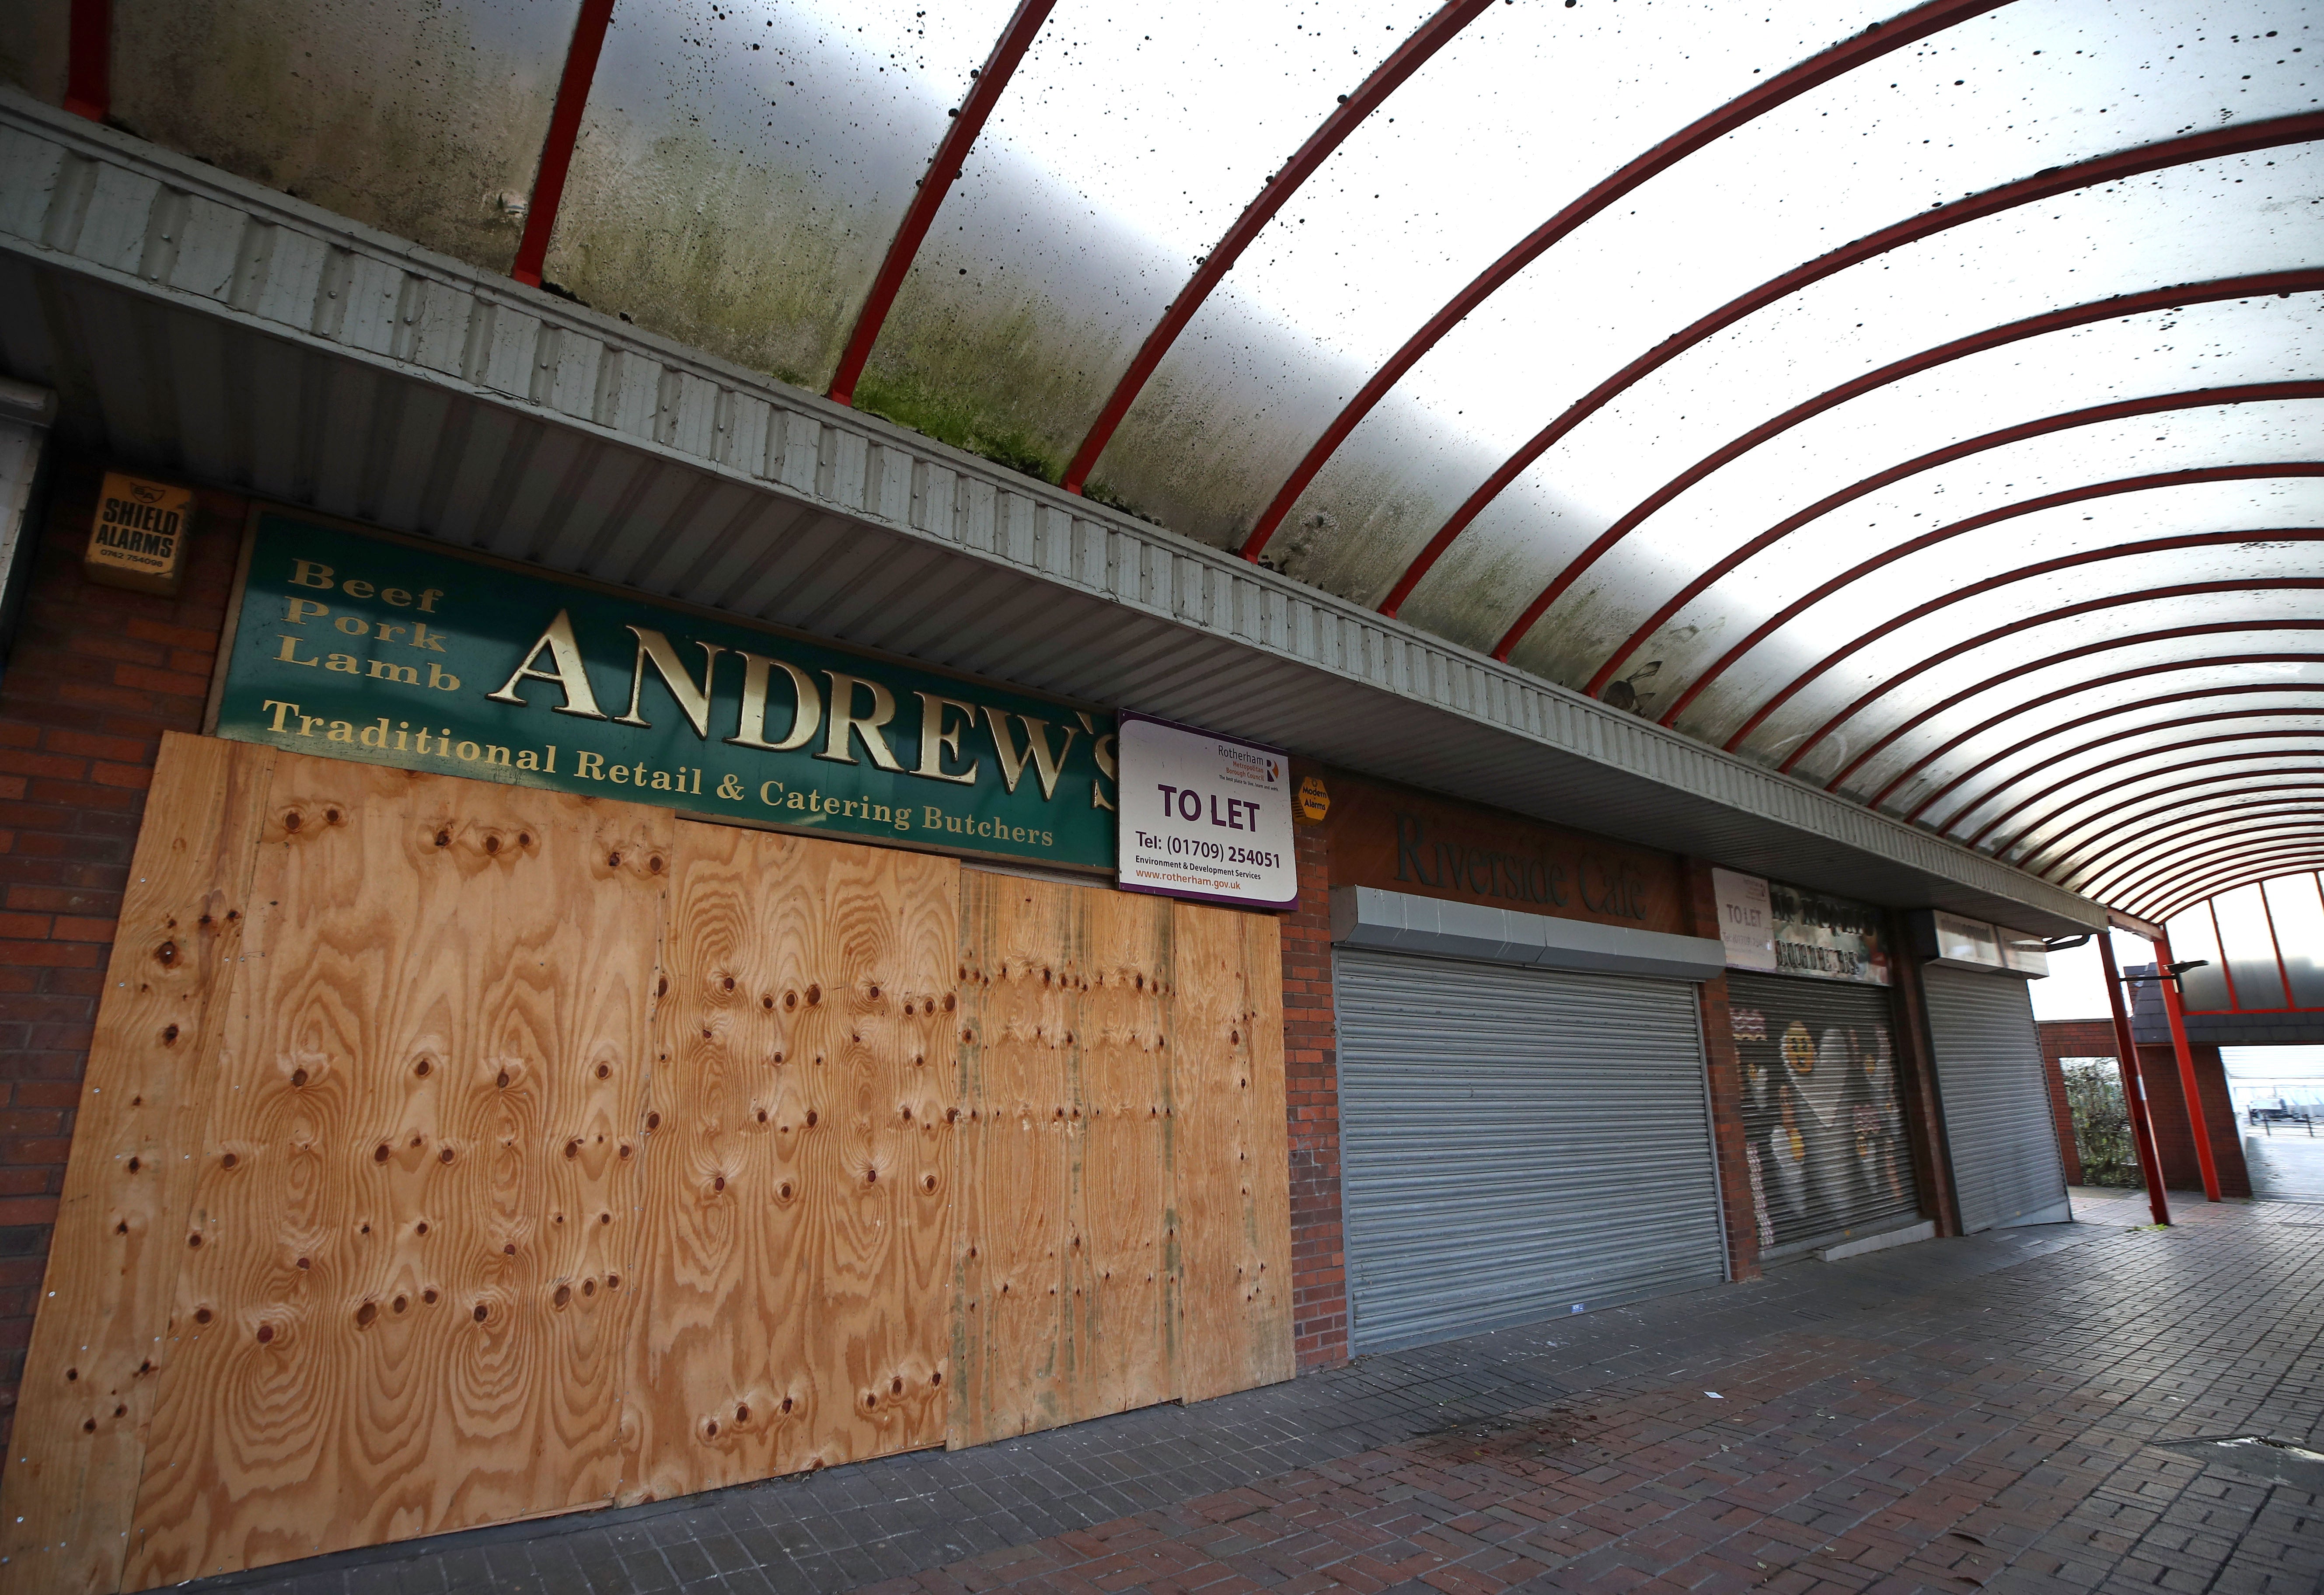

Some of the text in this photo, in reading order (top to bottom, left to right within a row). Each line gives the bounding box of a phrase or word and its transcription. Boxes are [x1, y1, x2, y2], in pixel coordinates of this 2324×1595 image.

[103, 497, 179, 536] SHIELD
[95, 524, 174, 558] ALARMS
[100, 549, 164, 567] 0742 754098
[287, 558, 445, 614] Beef
[279, 596, 447, 653] Pork
[272, 634, 461, 691] Lamb
[1218, 745, 1263, 766] Rotherham
[1232, 761, 1264, 774] Metropolitan
[262, 699, 1054, 847] Traditional Retail & Catering Butchers
[1226, 767, 1264, 782] Borough Council
[1302, 785, 1327, 799] Modern
[1304, 798, 1326, 811] Alarms
[1157, 783, 1260, 833] TO LET
[1135, 831, 1281, 869] Tel: (01709) 254051
[1392, 809, 1569, 908] Riverside
[1135, 855, 1262, 881] Environment & Development Services
[1135, 869, 1242, 891] www.rotherham.gov.uk
[1726, 903, 1742, 925] TO
[1744, 907, 1762, 928] LET
